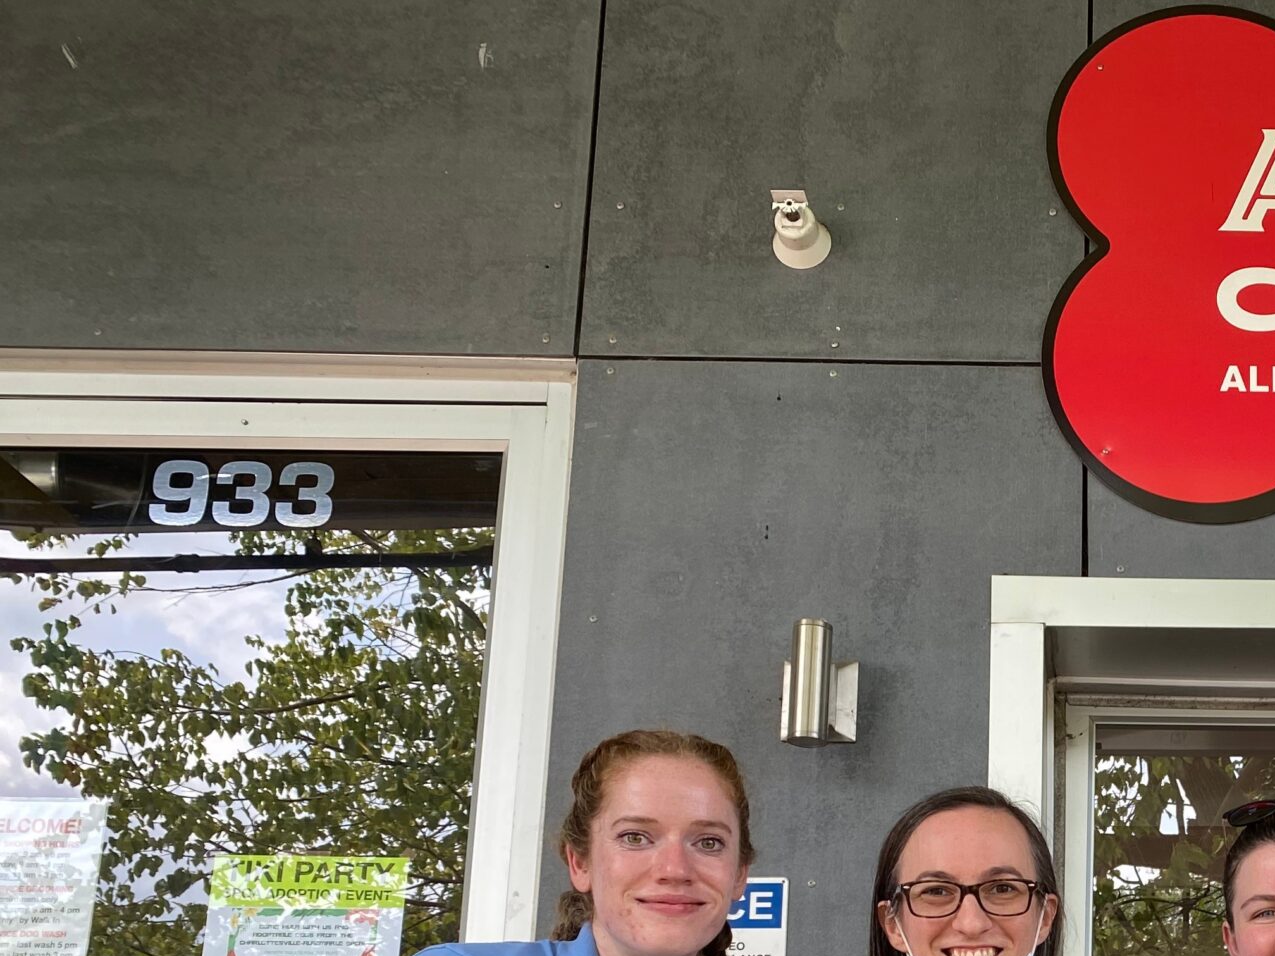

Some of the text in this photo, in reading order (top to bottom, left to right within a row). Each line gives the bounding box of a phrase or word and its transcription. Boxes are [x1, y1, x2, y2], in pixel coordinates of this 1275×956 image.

[148, 460, 336, 528] 933
[294, 861, 396, 884] PARTY
[265, 888, 342, 901] ADOPTION
[346, 890, 393, 901] EVENT
